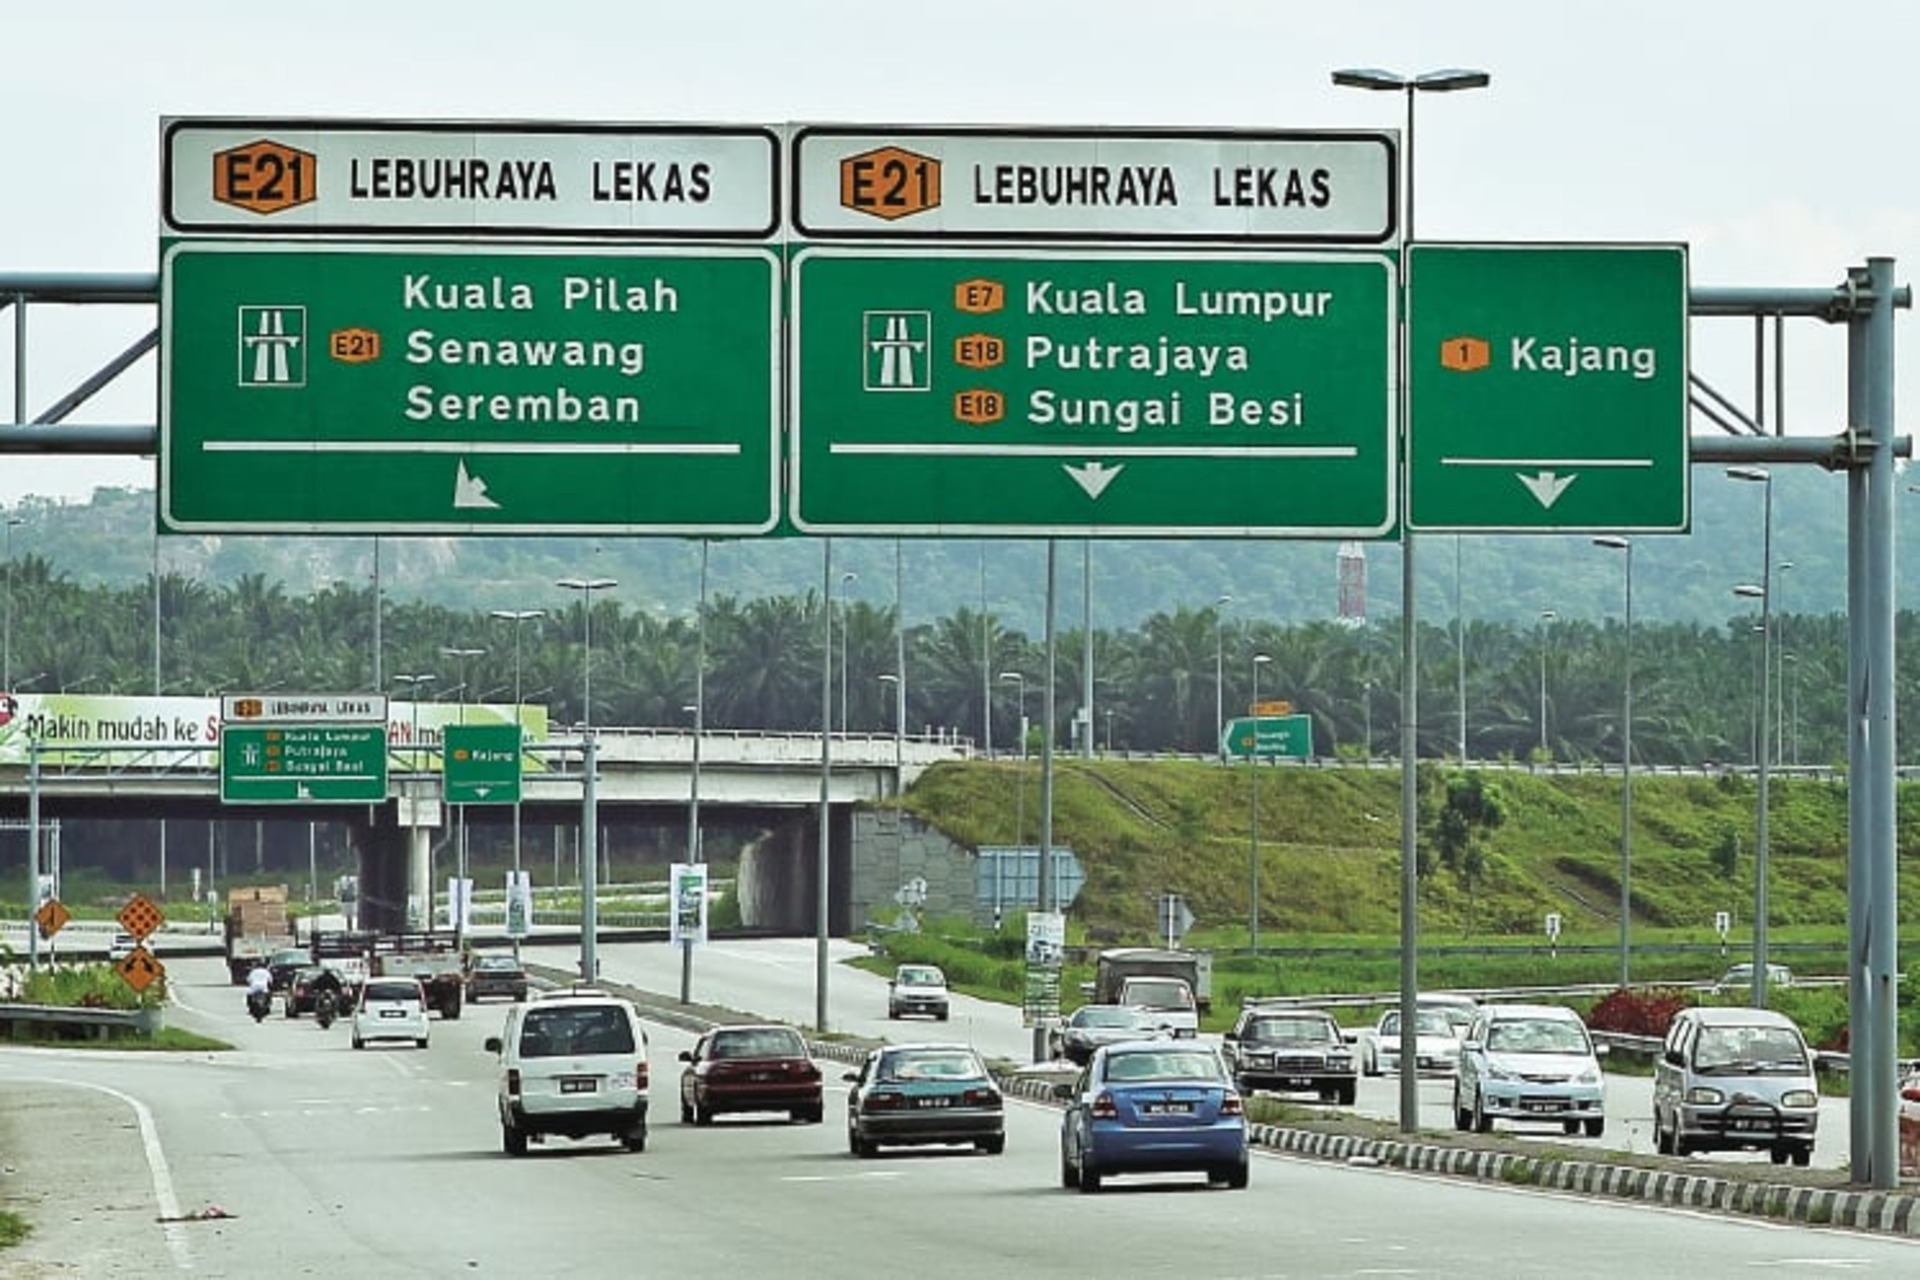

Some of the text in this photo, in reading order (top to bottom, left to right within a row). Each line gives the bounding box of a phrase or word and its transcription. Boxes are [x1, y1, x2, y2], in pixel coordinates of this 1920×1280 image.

[226, 154, 302, 200] E21
[351, 158, 711, 203] LEBUHRAYA LEKAS
[852, 160, 929, 204] E21
[974, 164, 1331, 208] LEBUHRAYA LEKAS
[404, 275, 679, 312] Kuala Pilah
[966, 286, 993, 307] E7
[1026, 281, 1332, 322] Kuala Lumpur
[335, 335, 375, 356] E21
[406, 329, 645, 376] Senawang
[961, 340, 999, 363] E18
[1026, 336, 1248, 377] Putrajaya
[1458, 344, 1469, 362] 1
[1511, 336, 1656, 378] Kajang
[405, 385, 639, 422] Seremban
[961, 395, 998, 418] E18
[1027, 390, 1303, 433] Sungai Besi
[27, 713, 90, 740] Makin
[97, 715, 168, 741] mudah
[174, 718, 199, 742] ke
